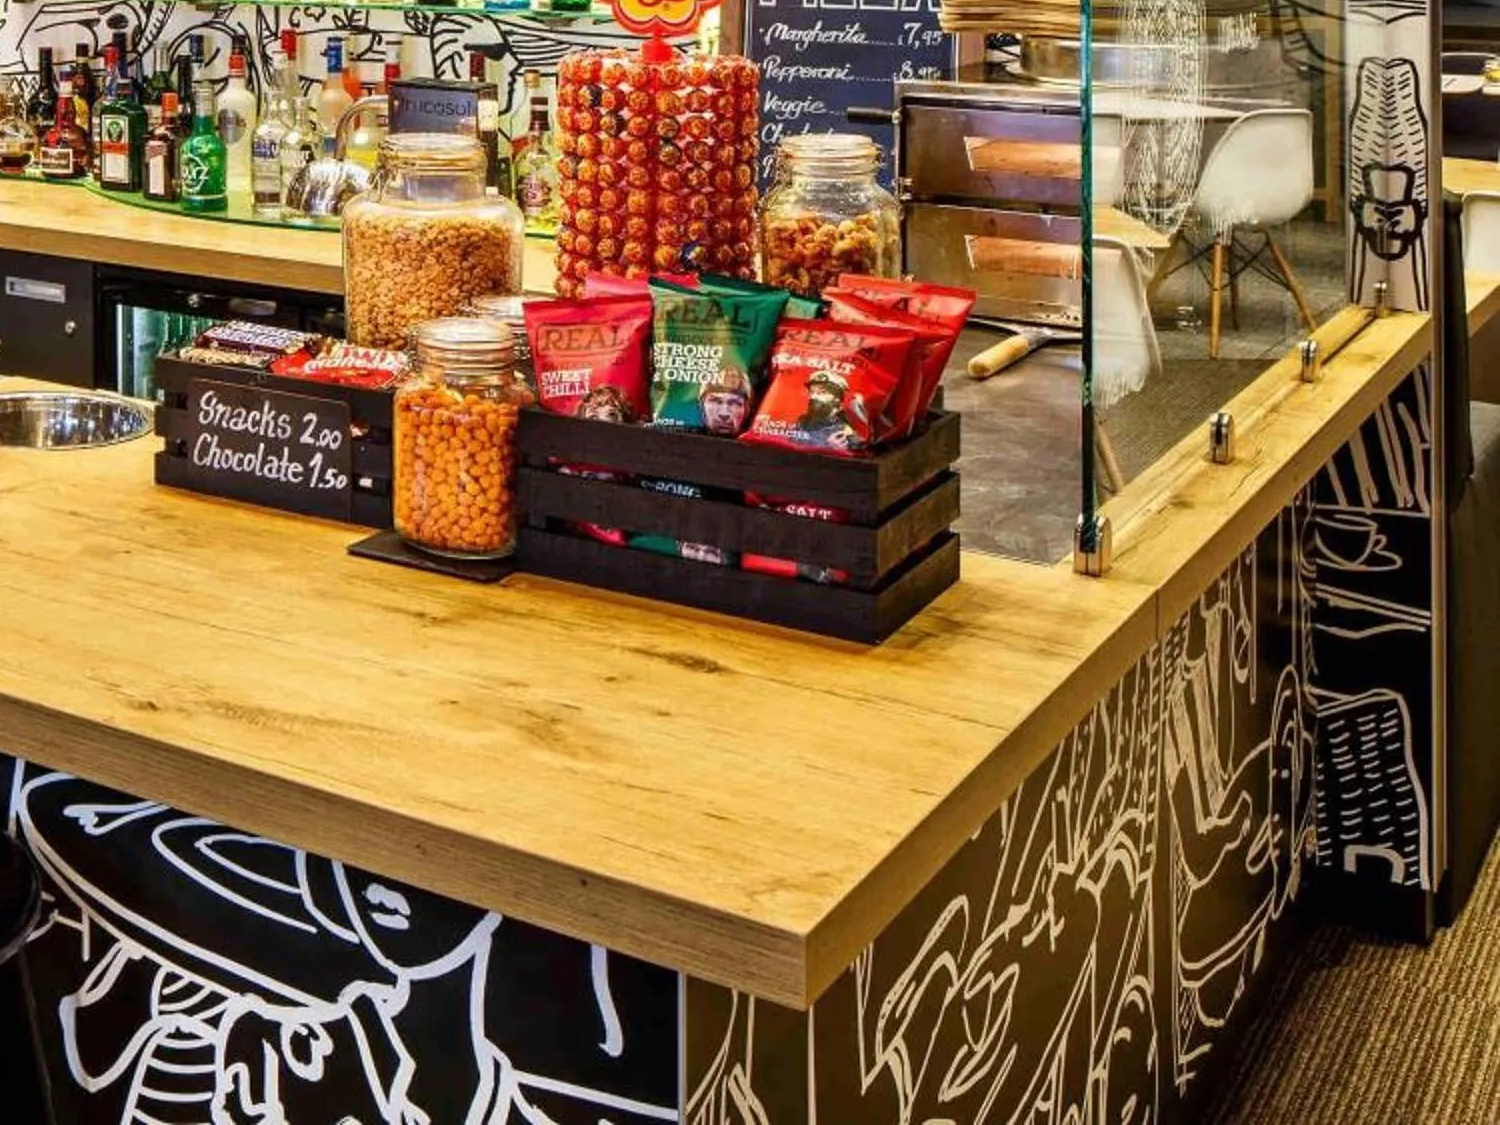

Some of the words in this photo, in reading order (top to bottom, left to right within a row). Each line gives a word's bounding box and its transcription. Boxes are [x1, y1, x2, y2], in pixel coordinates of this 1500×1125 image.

[764, 20, 868, 52] Margherita
[762, 54, 854, 83] Pepperoni
[763, 89, 827, 120] Veggie
[652, 342, 724, 361] STRONG
[652, 356, 721, 372] CHEESE
[541, 367, 594, 386] SWEET
[664, 367, 726, 386] ONION
[541, 382, 591, 399] CHILLI
[198, 390, 292, 439] Snacks
[193, 432, 305, 483] Chocolate
[308, 451, 349, 490] 1.50
